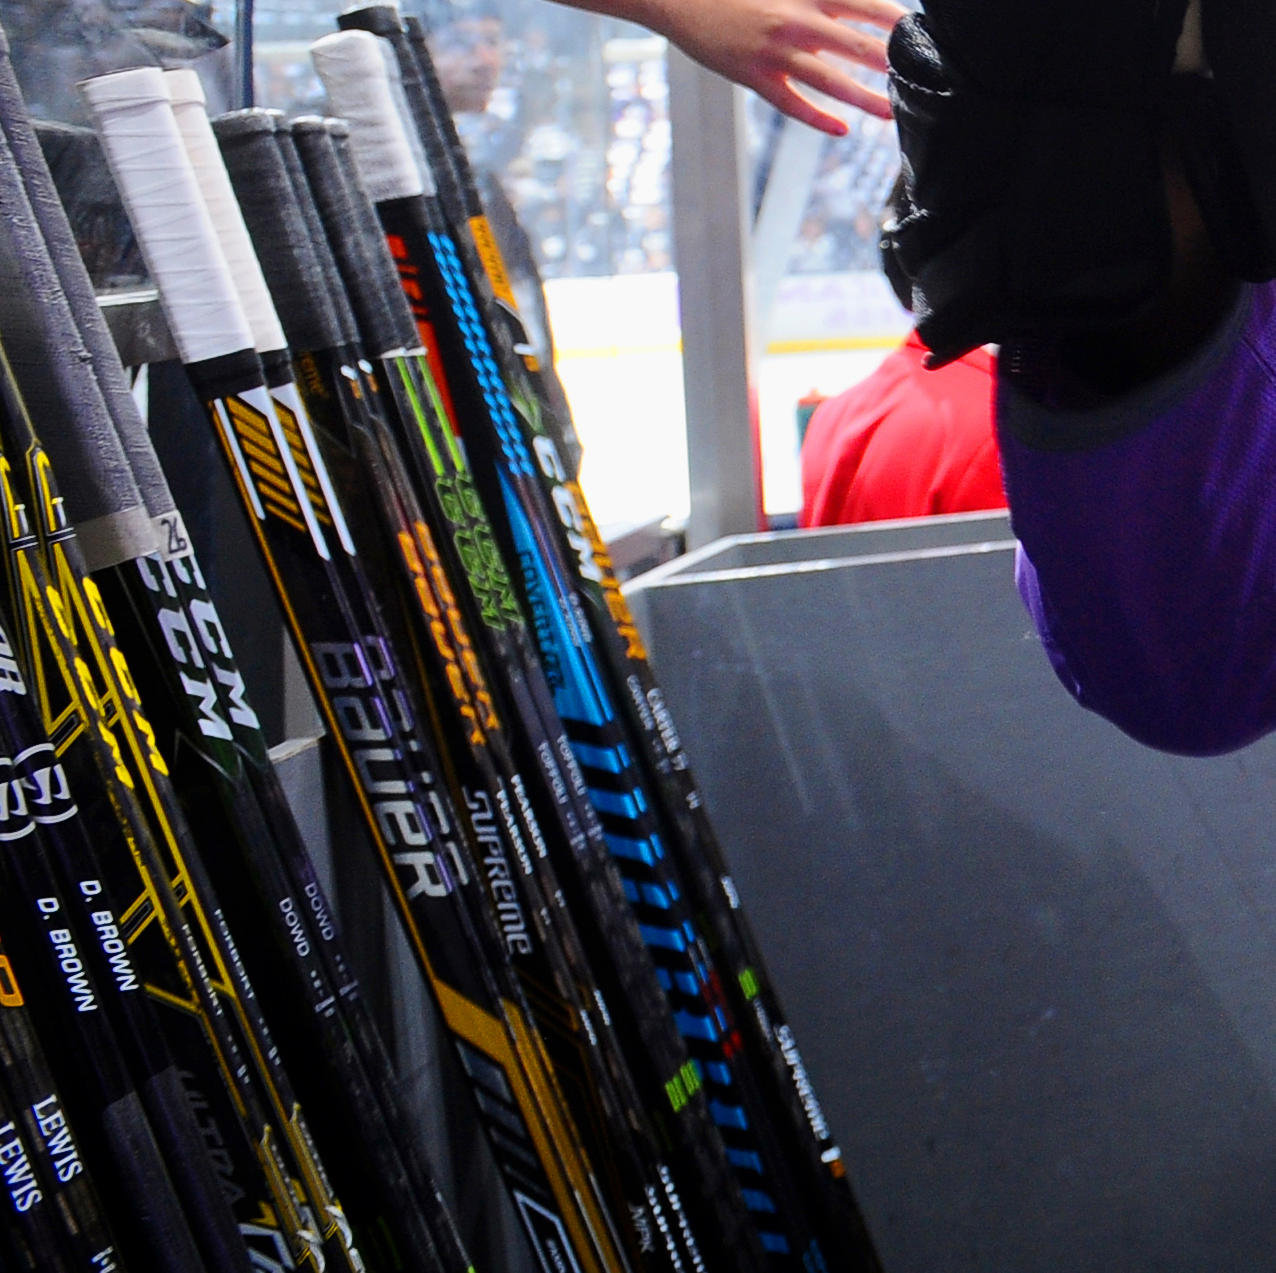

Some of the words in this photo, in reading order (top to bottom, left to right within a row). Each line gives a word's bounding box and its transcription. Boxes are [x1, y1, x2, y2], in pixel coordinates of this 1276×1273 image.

[534, 434, 603, 581] CCM
[37, 896, 60, 920] D.
[49, 928, 98, 1012] BROWN
[79, 879, 102, 903] D.
[91, 910, 139, 992] BROWN
[279, 896, 311, 957] DOWD
[304, 882, 334, 941] DOWD
[31, 1093, 84, 1183] LEWIS
